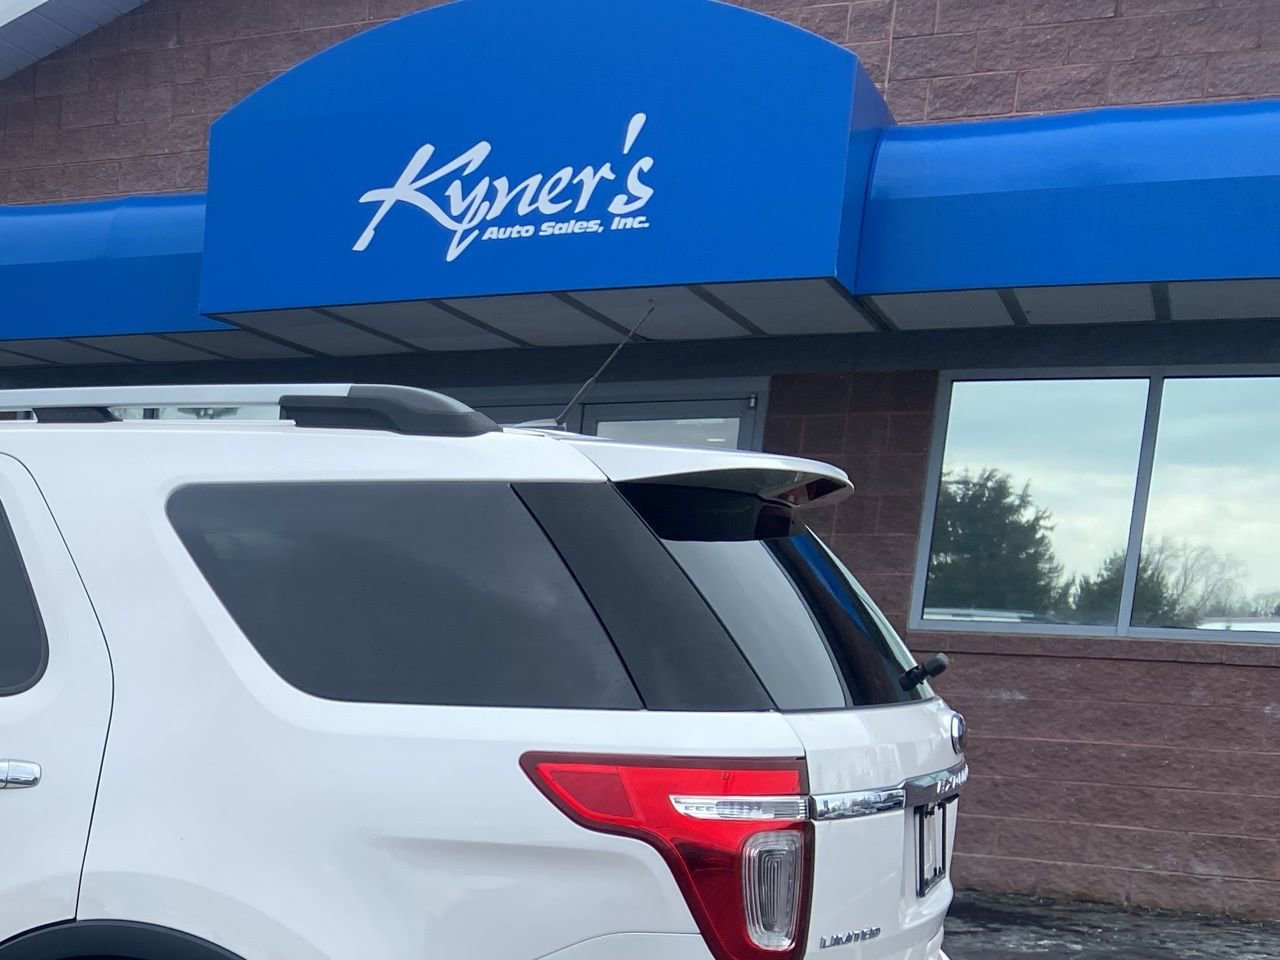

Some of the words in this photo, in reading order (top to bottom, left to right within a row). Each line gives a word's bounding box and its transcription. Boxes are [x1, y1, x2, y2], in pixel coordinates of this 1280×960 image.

[352, 112, 654, 262] Kyner's
[481, 224, 535, 241] Auto
[538, 219, 605, 236] Sales,
[610, 215, 650, 230] Inc.
